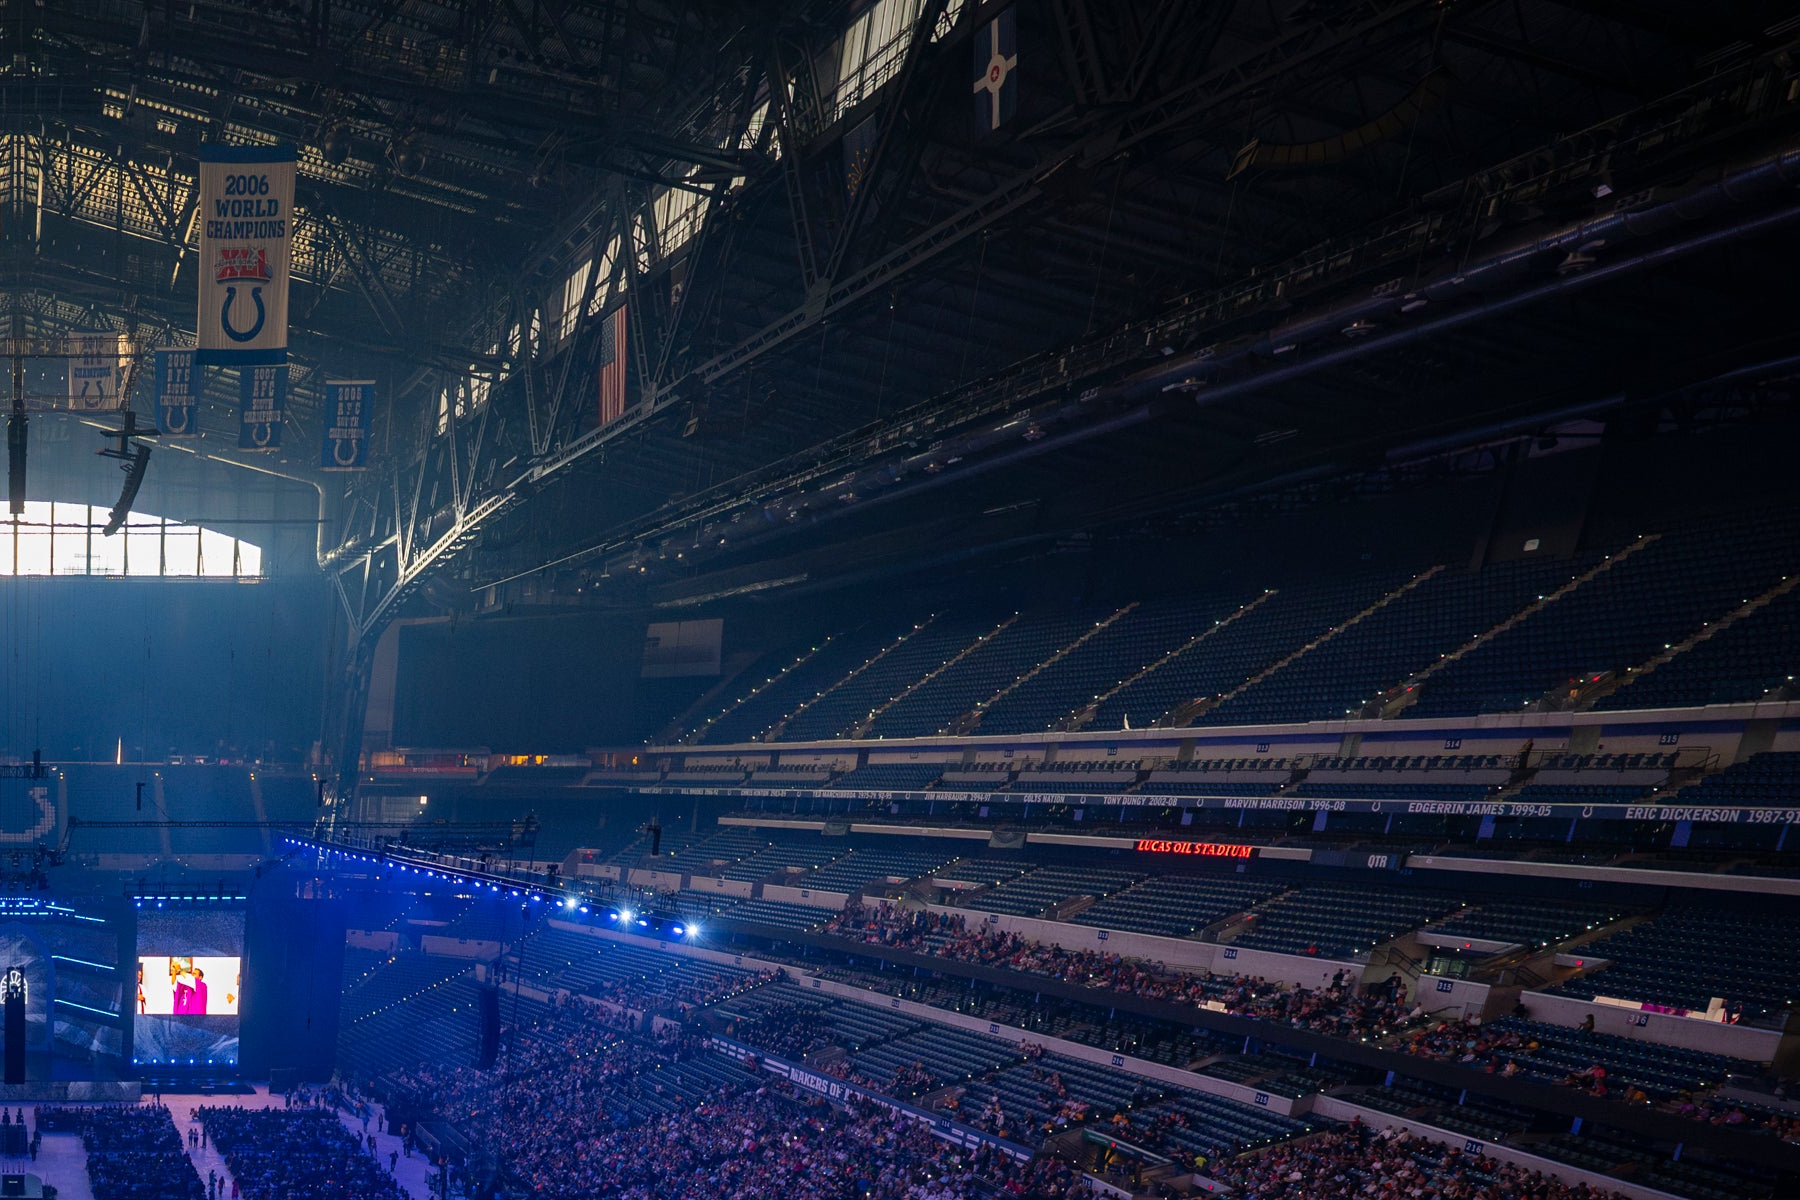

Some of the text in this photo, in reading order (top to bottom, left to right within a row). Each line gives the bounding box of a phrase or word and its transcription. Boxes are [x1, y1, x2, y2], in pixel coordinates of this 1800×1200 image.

[225, 174, 269, 196] 2006
[216, 199, 278, 218] WORLD
[207, 220, 285, 239] CHAMPIONS
[254, 368, 276, 380] 2007
[253, 381, 275, 397] AFC
[1445, 740, 1460, 748] 514
[1661, 734, 1678, 744] 515
[924, 793, 991, 802] JIM HARBAUGH 1994-97
[1023, 795, 1065, 804] COLTS NATION
[1103, 796, 1177, 806] TONY DUNGY 2002-08
[1224, 799, 1345, 811] MARVIN HARRISON 1996-08
[1408, 802, 1551, 816] EDGERRIN JAMES 1999-05
[1625, 807, 1800, 824] ERIC DICKERSON 1987-91
[1137, 839, 1253, 858] LUCAS OIL STADIUM
[1367, 854, 1388, 869] QTR
[1224, 949, 1237, 959] 314
[1437, 981, 1452, 992] 315
[1628, 1014, 1646, 1025] 316
[1113, 1056, 1123, 1066] 214
[790, 1067, 828, 1094] MAKERS
[830, 1082, 843, 1098] OF
[1256, 1094, 1268, 1105] 215
[1466, 1142, 1482, 1154] 216
